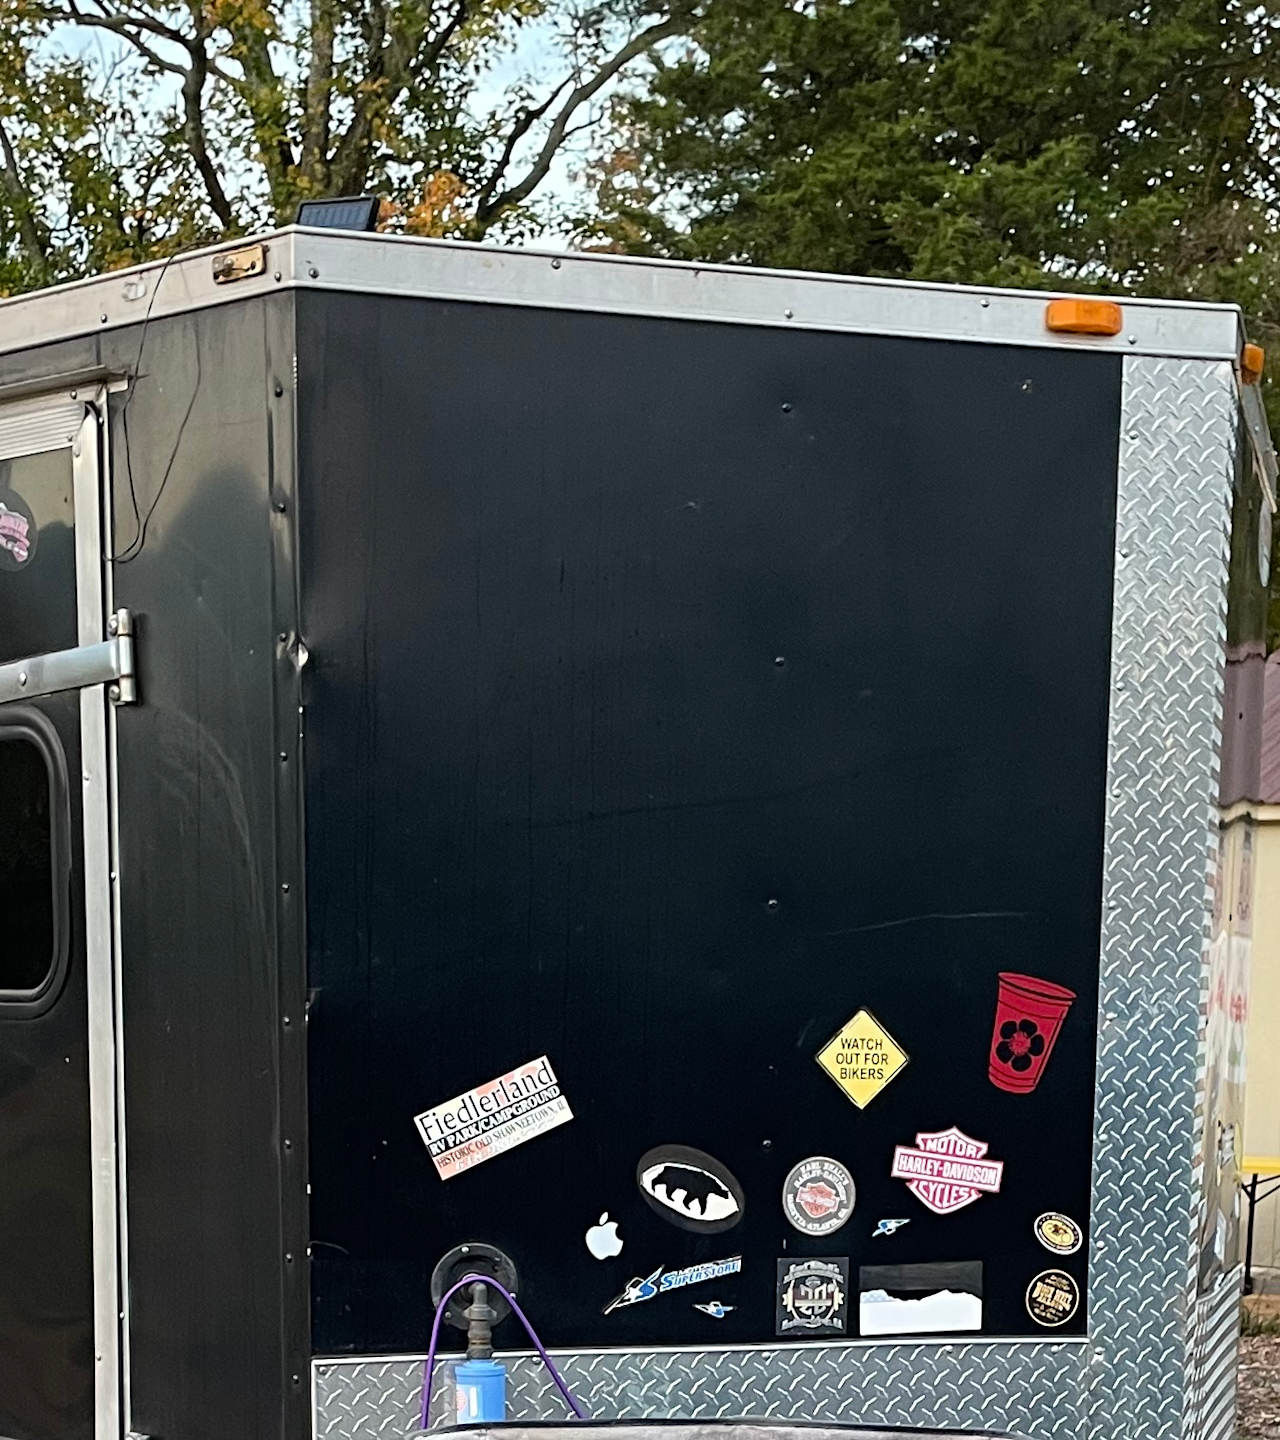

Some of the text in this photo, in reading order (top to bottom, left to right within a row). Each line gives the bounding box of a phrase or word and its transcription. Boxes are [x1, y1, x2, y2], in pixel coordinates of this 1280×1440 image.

[841, 1038, 883, 1050] WATCH
[836, 1053, 888, 1065] OUT FOR
[840, 1068, 884, 1080] BIKERS
[420, 1060, 553, 1141] Fiedlerland
[429, 1138, 446, 1157] RV
[447, 1085, 561, 1148] PARK/CAMPGROUND
[437, 1143, 474, 1168] HISTORIC
[475, 1134, 493, 1150] OLD
[926, 1134, 978, 1158] MOTOR
[899, 1154, 997, 1185] HARLEY-DAVIDSON
[918, 1180, 971, 1208] CYCLES
